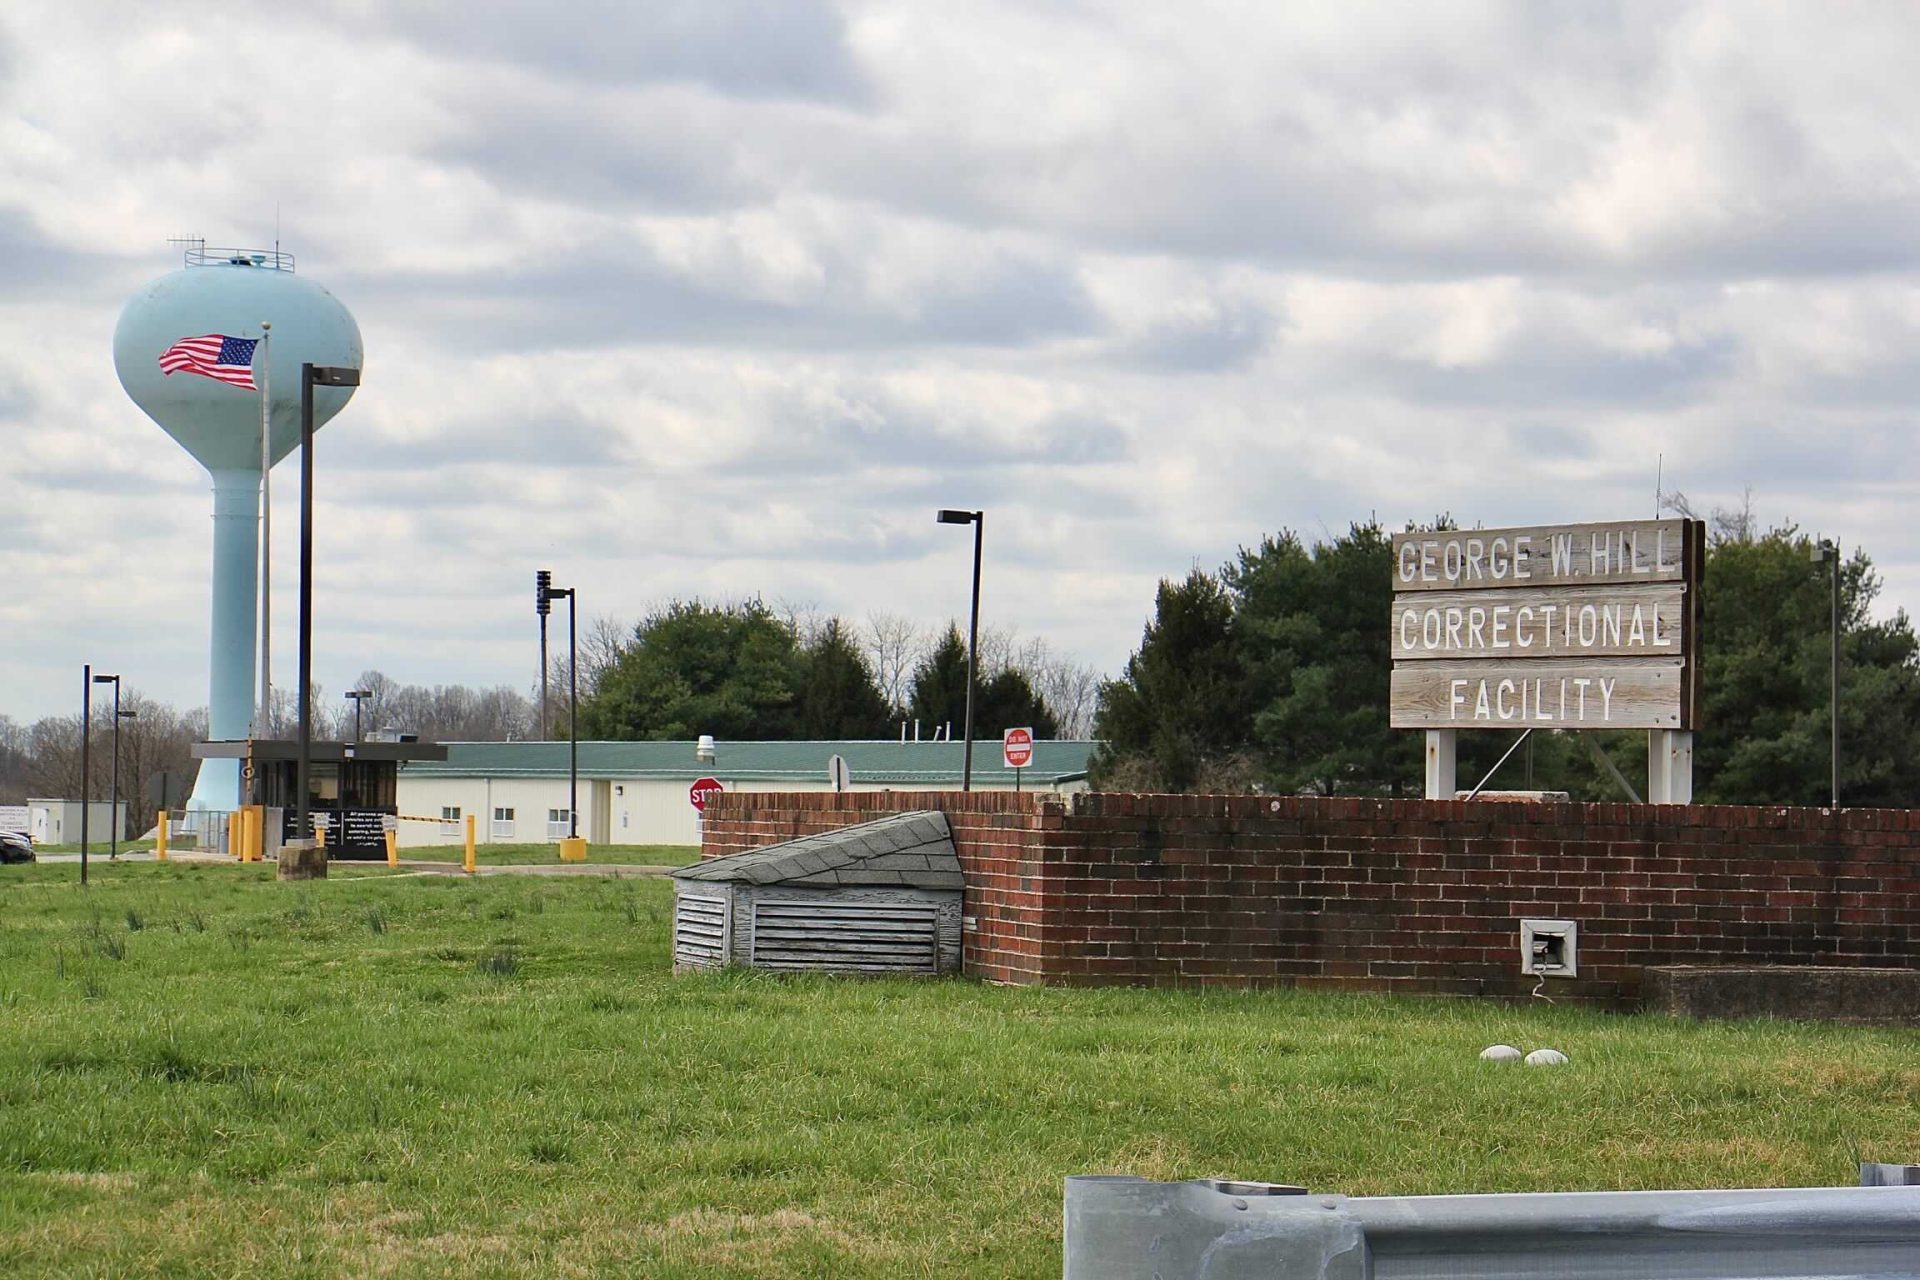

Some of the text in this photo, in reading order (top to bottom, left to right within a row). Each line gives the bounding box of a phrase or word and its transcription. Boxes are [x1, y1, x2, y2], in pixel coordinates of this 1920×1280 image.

[1399, 536, 1532, 582] GEORGE
[1400, 602, 1671, 650] CORRECTIONAL
[1450, 678, 1616, 721] FACILITY
[1010, 752, 1027, 760] ENTER
[692, 788, 722, 803] ST
